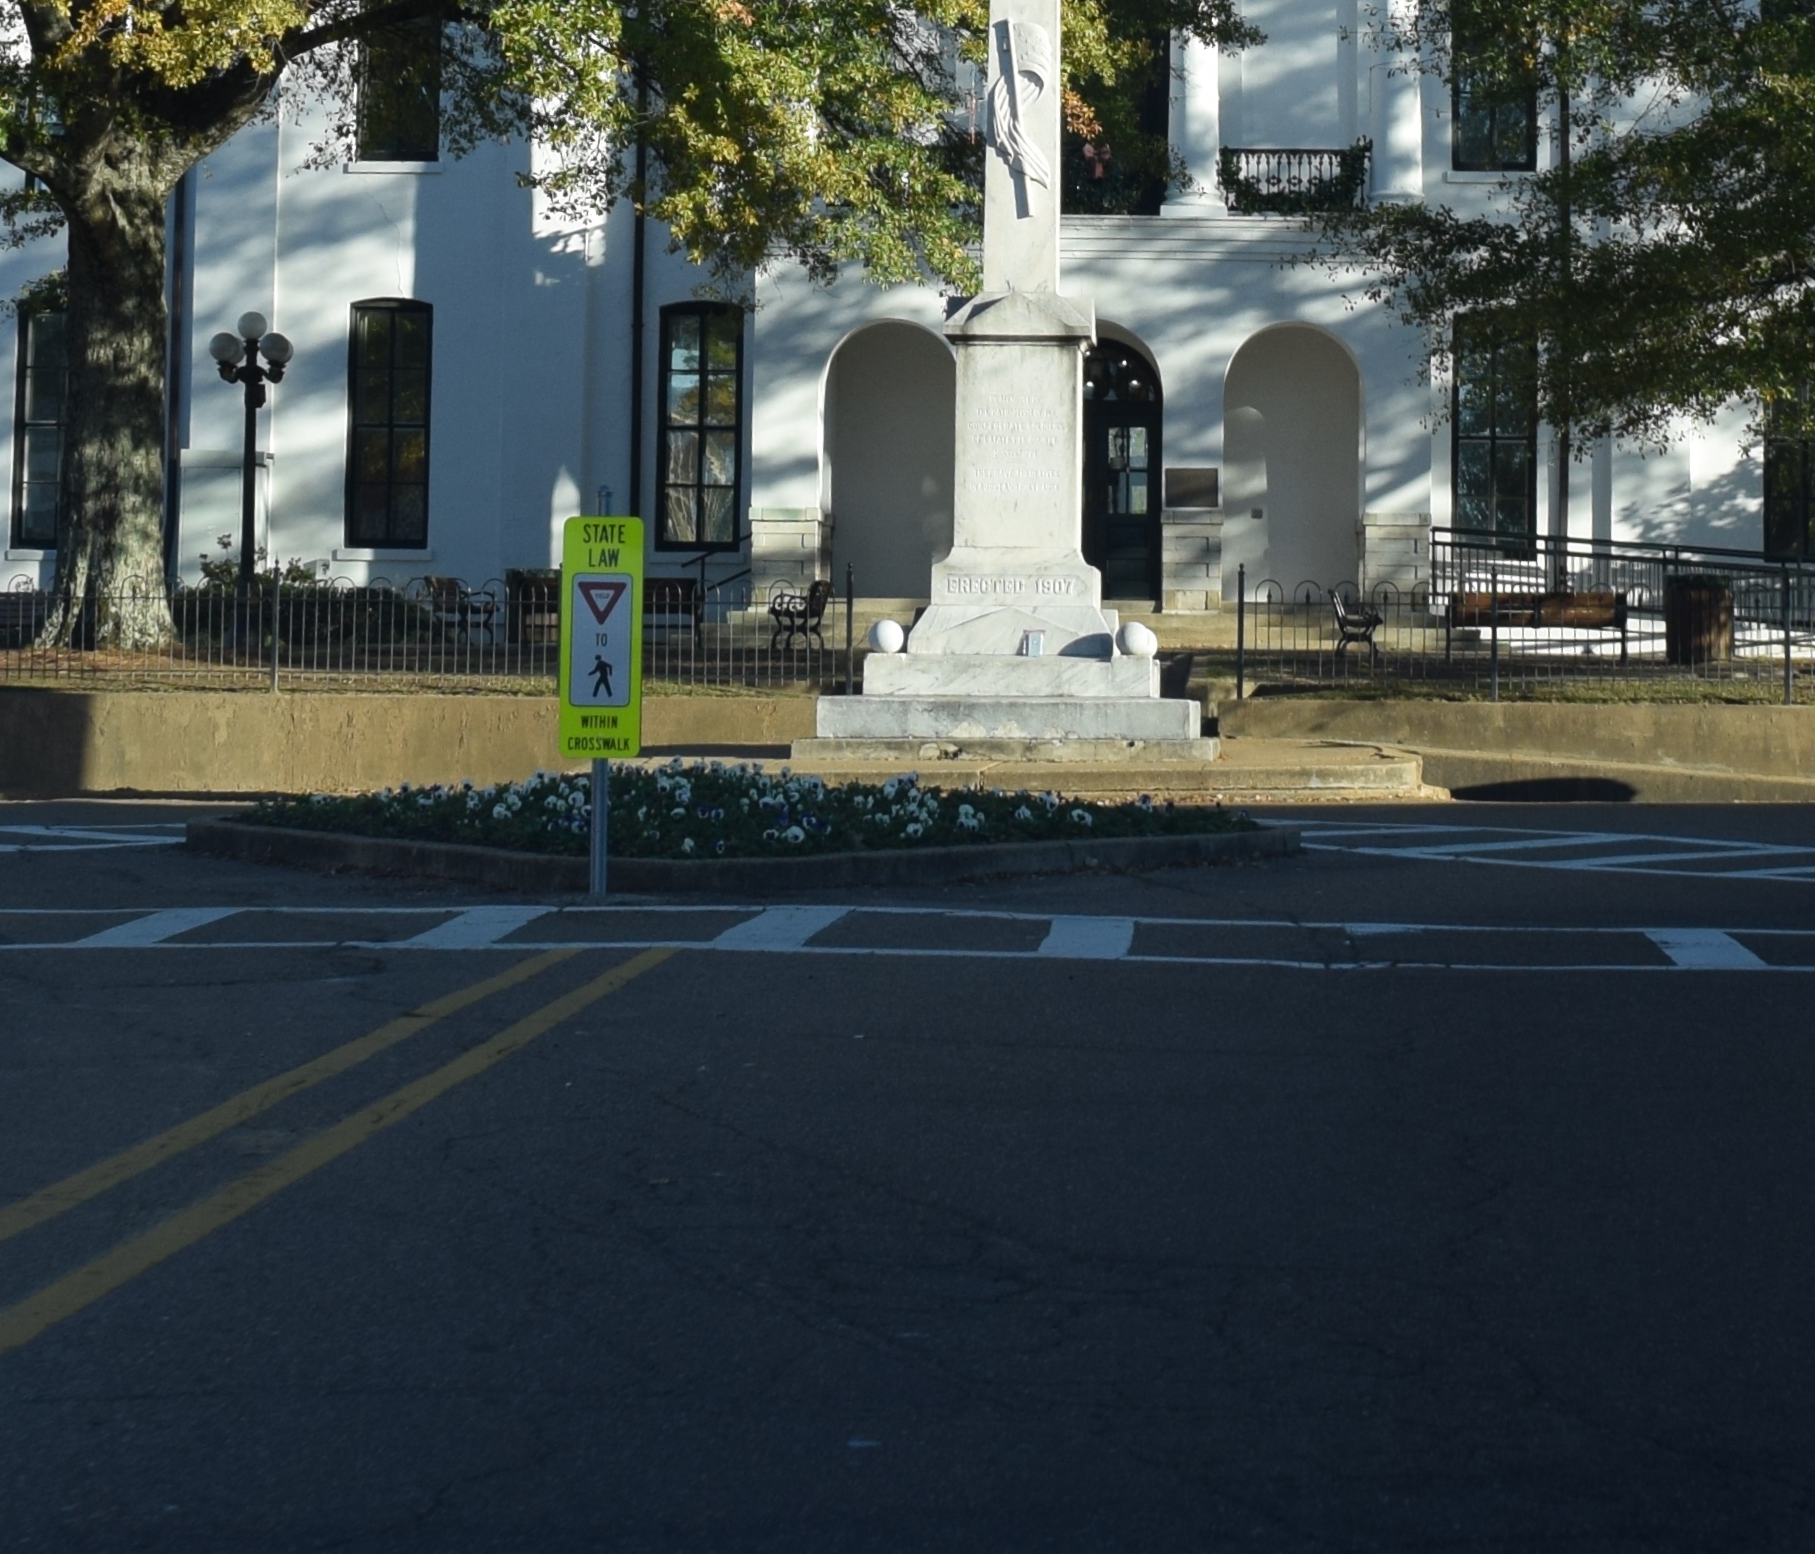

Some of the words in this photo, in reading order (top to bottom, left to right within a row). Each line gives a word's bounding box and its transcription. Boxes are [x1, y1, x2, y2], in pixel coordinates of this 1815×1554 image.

[582, 523, 627, 544] STATE
[588, 548, 620, 568] LAW
[946, 576, 1026, 595] ERECTED
[1036, 577, 1076, 595] 1907
[595, 632, 609, 647] TO
[580, 715, 619, 729] WITHIN
[567, 736, 631, 752] CROSSWALK
